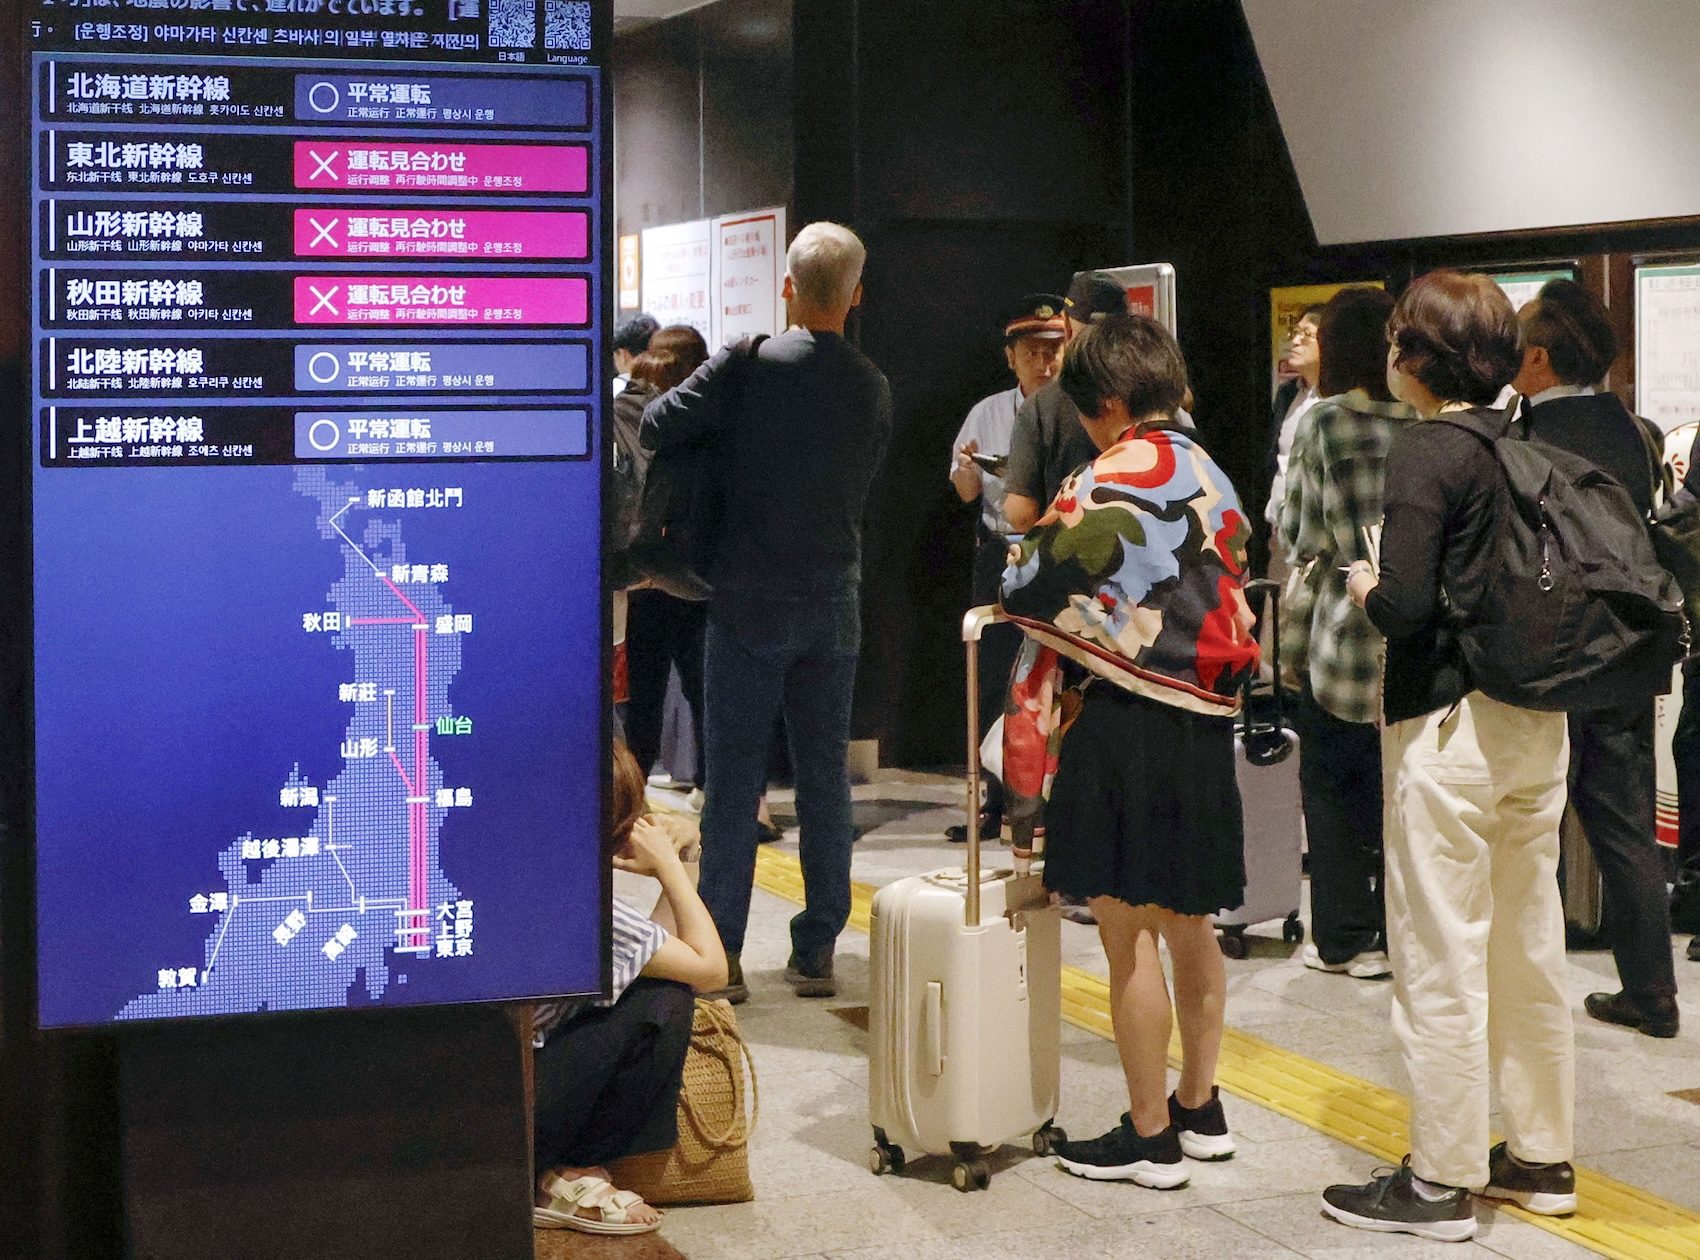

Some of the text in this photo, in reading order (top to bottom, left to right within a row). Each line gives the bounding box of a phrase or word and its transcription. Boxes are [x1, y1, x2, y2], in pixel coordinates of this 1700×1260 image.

[75, 23, 148, 41] [운행조정]
[154, 25, 216, 42] 야마가타
[223, 27, 268, 44] 신칸센
[274, 29, 319, 45] 츠바사
[324, 29, 339, 45] 의
[497, 51, 526, 63] 日本語
[546, 53, 589, 65] Language
[67, 72, 231, 101] 北海道新幹線
[347, 83, 431, 104] 平常運転
[66, 102, 286, 119] 北海道新干线 北海道新幹線 홋카이도 신칸센
[346, 107, 496, 122] 正常运行 正常運行 평상시 운행
[67, 141, 204, 169] 東北新幹線
[347, 150, 466, 172] 運転見合わせ
[66, 171, 254, 186] 东北新干线 東北新幹線 도호쿠 신칸센
[346, 174, 391, 187] 运行调整
[483, 176, 524, 188] 운행조정
[67, 211, 204, 237] 山形新幹線
[347, 218, 466, 239] 運転見合わせ
[66, 239, 264, 254] 山形新干线 山形新幹線 야마가타 신칸센
[346, 241, 391, 254] 运行调整
[483, 242, 524, 255] 운행조정
[67, 279, 204, 306] 秋田新幹線
[347, 285, 466, 306] 運転見合わせ
[66, 308, 254, 322] 秋田新干线 秋田新幹線 아키타 신칸센
[346, 309, 391, 322] 运行调整
[483, 308, 524, 321] 운행조정
[67, 348, 204, 375] 北陸新幹線
[347, 352, 431, 372] 平常運転
[127, 377, 184, 390] 北陸新幹線
[187, 376, 230, 390] 호쿠리쿠
[231, 376, 264, 390] 신칸센
[346, 374, 496, 388] 正常运行 正常運行 평상시 운행
[67, 416, 204, 443] 上越新幹線
[347, 419, 431, 439] 平常運転
[66, 444, 254, 460] 上越新干线 上越新幹線 조에츠 신칸센
[346, 441, 496, 456] 正常运行 正常運行 평상시 운행
[391, 563, 449, 583] 新青森
[302, 612, 341, 632] 秋田
[435, 614, 472, 634] 盛岡
[435, 715, 472, 735] 仙台
[340, 738, 378, 758] 山形
[434, 787, 473, 807] 福島
[437, 901, 473, 920] 大宮
[437, 920, 473, 939] 上野
[436, 938, 473, 957] 東京
[157, 968, 197, 988] 敦賀
